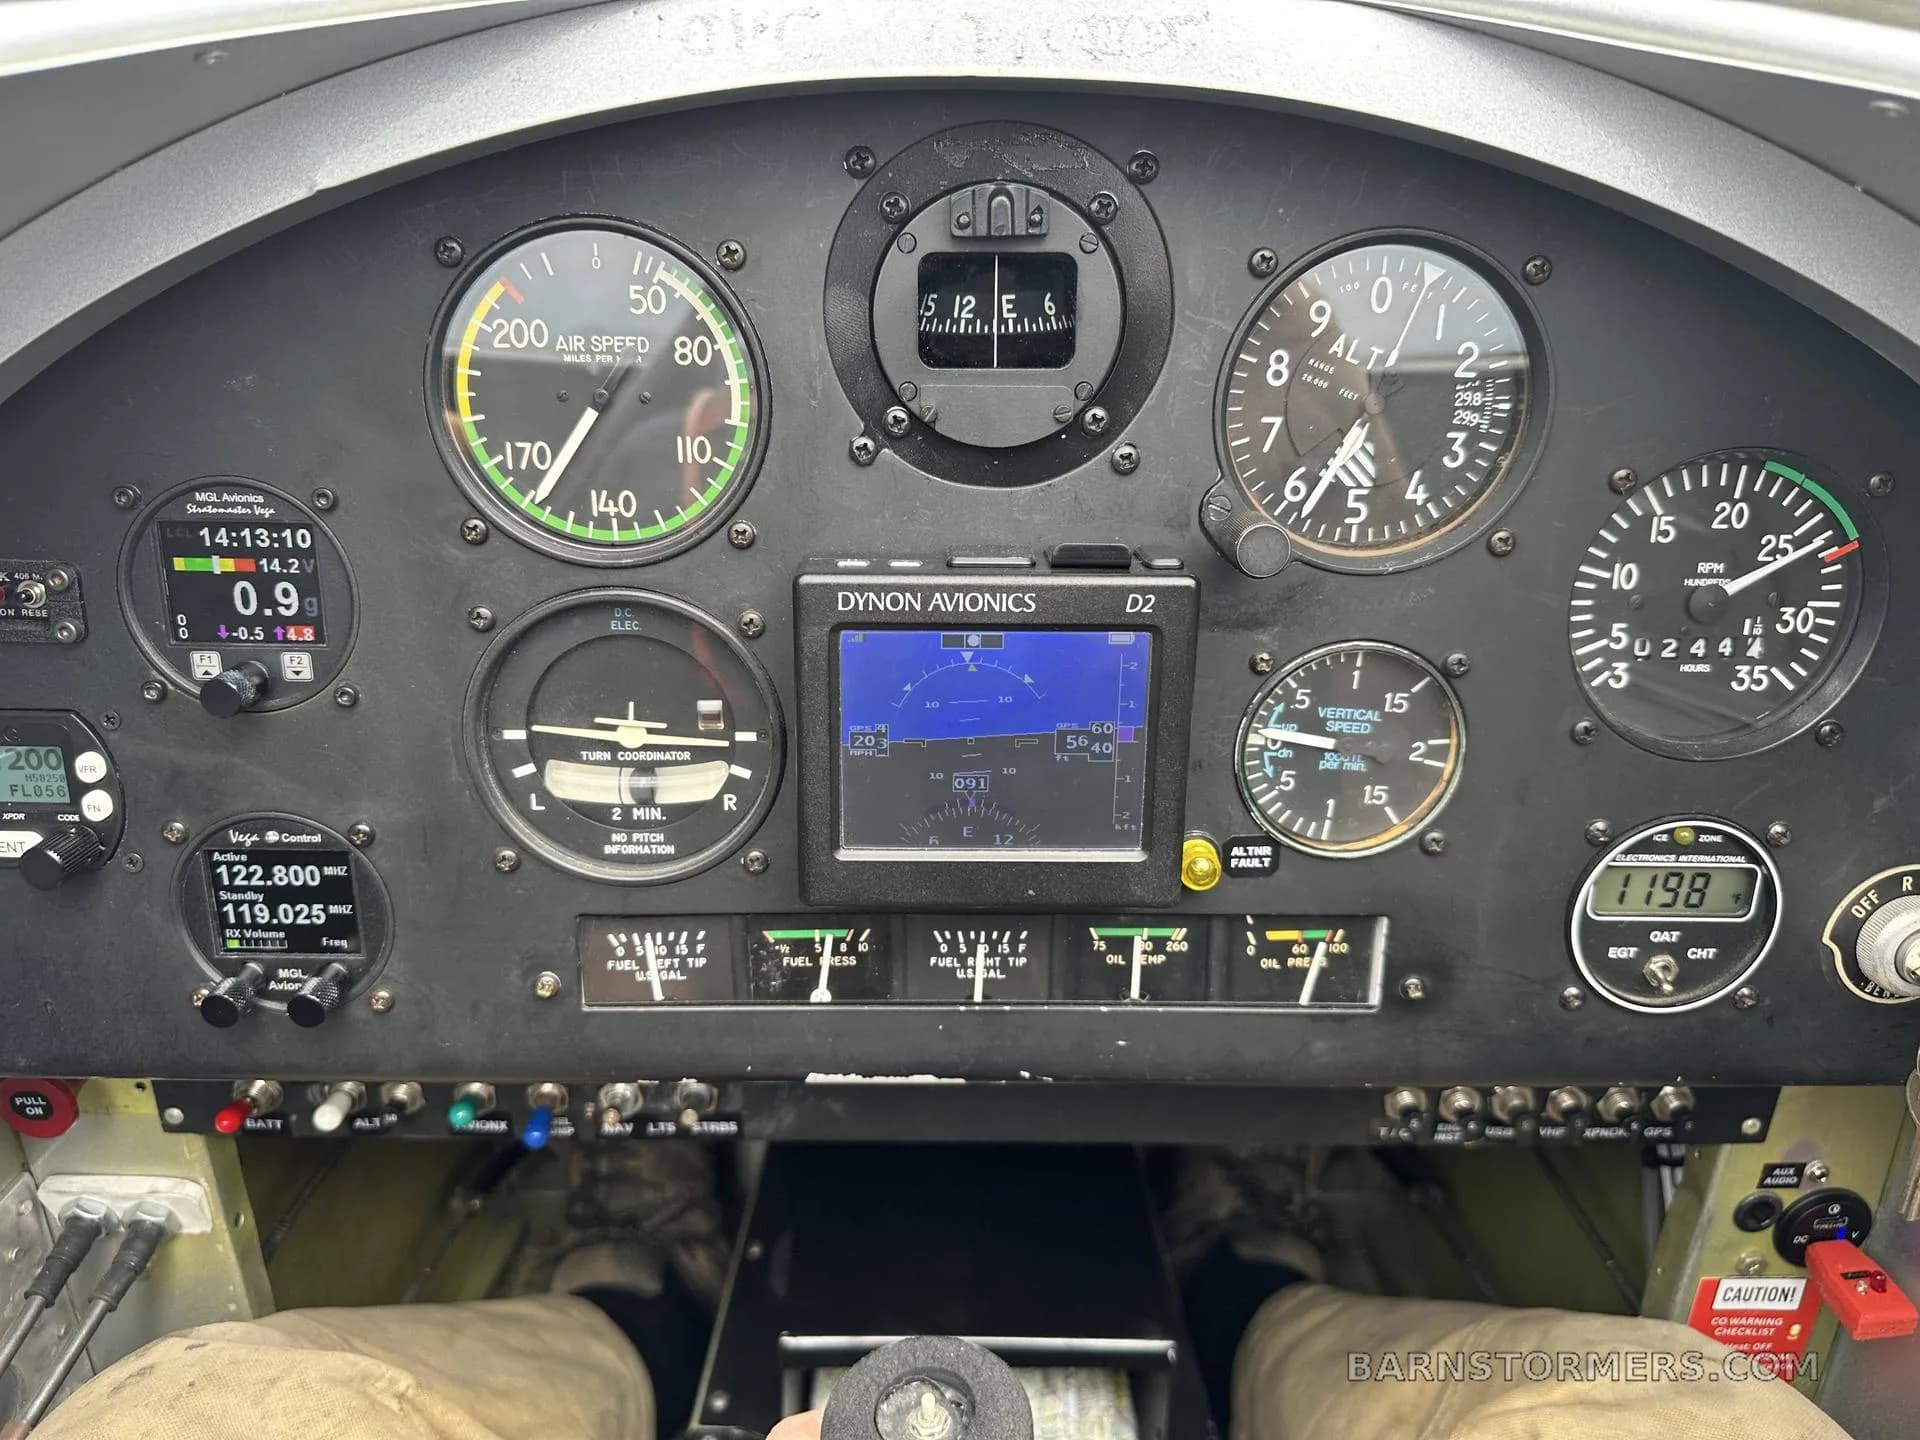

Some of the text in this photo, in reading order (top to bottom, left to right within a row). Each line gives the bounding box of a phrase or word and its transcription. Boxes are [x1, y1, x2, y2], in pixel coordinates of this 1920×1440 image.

[629, 285, 667, 315] 50
[1371, 276, 1392, 313] 0
[920, 292, 1056, 318] 15 12 E 6
[1309, 300, 1332, 337] 9
[1435, 303, 1446, 341] 1
[492, 319, 548, 348] 200
[555, 335, 585, 352] AIR
[674, 336, 713, 366] 80
[1328, 333, 1385, 370] ALT
[563, 354, 592, 363] MILES
[595, 355, 613, 363] PER
[1454, 341, 1479, 378] 2
[1266, 349, 1289, 386] 8
[1338, 387, 1360, 400] FEET
[1454, 391, 1481, 406] 29.8
[1452, 409, 1480, 427] 29.9
[1261, 416, 1283, 453] 7
[505, 441, 551, 470] 170
[676, 436, 712, 464] 110
[1442, 431, 1467, 468] 3
[1284, 466, 1308, 502] 6
[1405, 470, 1430, 506] 4
[195, 492, 264, 503] MGL Avionics
[591, 490, 636, 517] 140
[186, 503, 276, 518] Stratomaster Vega
[1344, 487, 1370, 524] 5
[1711, 501, 1749, 530] 20
[1650, 515, 1676, 543] 15
[199, 527, 313, 549] 14:13:10
[1757, 534, 1794, 562] 25
[258, 558, 300, 573] 14.2
[1696, 562, 1725, 574] RPM
[1612, 562, 1638, 590] 10
[232, 580, 319, 617] 0.9 g
[837, 591, 1156, 614] DYNON AVIONICS D2
[614, 607, 635, 618] D.C.
[176, 614, 187, 626] 0
[610, 620, 643, 631] ELEC.
[1775, 606, 1814, 634] 30
[179, 627, 314, 641] 0 -0.5 4.8
[1609, 623, 1629, 650] 5
[199, 655, 212, 664] F1
[289, 656, 303, 665] F2
[1608, 662, 1628, 689] 3
[1679, 664, 1711, 673] HOURS
[1351, 669, 1361, 690] 1
[1730, 664, 1770, 692] 35
[1290, 688, 1312, 710] .5
[1383, 691, 1410, 713] 1.5
[1318, 706, 1383, 722] VERTICAL
[1091, 722, 1114, 734] 60
[1325, 720, 1373, 734] SPEED
[1090, 742, 1113, 753] 40
[1409, 741, 1425, 761] 2
[580, 751, 692, 762] TURN COORDINATOR
[78, 765, 97, 774] VFR
[1318, 760, 1341, 771] per
[954, 778, 987, 789] 091
[1274, 770, 1297, 791] .5
[9, 784, 67, 798] FL056
[1363, 785, 1390, 805] 1.5
[530, 793, 546, 811] L
[723, 793, 737, 811] R
[1326, 798, 1336, 818] 1
[2, 812, 80, 822] XPDR CODE
[611, 807, 667, 821] 2 MIN.
[229, 829, 322, 847] Vega Control
[611, 832, 665, 843] NO PITCH
[962, 826, 1014, 845] E 12
[1652, 834, 1723, 843] ICE ZONE
[603, 844, 675, 855] INFORMATION
[1230, 846, 1272, 857] ALTNR
[213, 852, 248, 862] Active
[1230, 857, 1271, 868] FAULT
[1615, 854, 1747, 864] ELECTRONICS INTERNATIONAL
[215, 864, 348, 886] 122.800 MHZ
[219, 890, 264, 903] Standby
[1617, 871, 1712, 908] 1198
[1850, 875, 1914, 919] OFF R
[222, 903, 353, 925] 119.025 MHZ
[226, 928, 348, 949] RX Volume Freq
[615, 943, 689, 957] 0 10 15
[857, 942, 869, 953] 10
[997, 943, 1010, 954] 15
[1092, 940, 1188, 952] 75 260
[1246, 943, 1349, 957] 0 60 100
[1607, 947, 1717, 959] EGT CHT
[606, 957, 707, 971] FUEL TIP
[782, 956, 813, 967] FUEL
[929, 956, 1028, 967] FUEL TIP
[1105, 954, 1127, 965] OIL
[1260, 958, 1281, 970] OIL
[278, 968, 304, 978] MGL
[14, 1096, 47, 1106] PULL
[25, 1105, 44, 1116] ON
[245, 1117, 283, 1129] BATT
[352, 1117, 381, 1129] ALT
[601, 1122, 677, 1136] NAV LTS
[1772, 1167, 1796, 1176] AUX
[1763, 1176, 1799, 1185] AUDIO
[1793, 1234, 1809, 1244] DC
[1721, 1285, 1797, 1304] CAUTION!
[1729, 1316, 1784, 1327] WARNING
[1714, 1326, 1777, 1337] CHECKLIST
[1752, 1342, 1774, 1351] OFF
